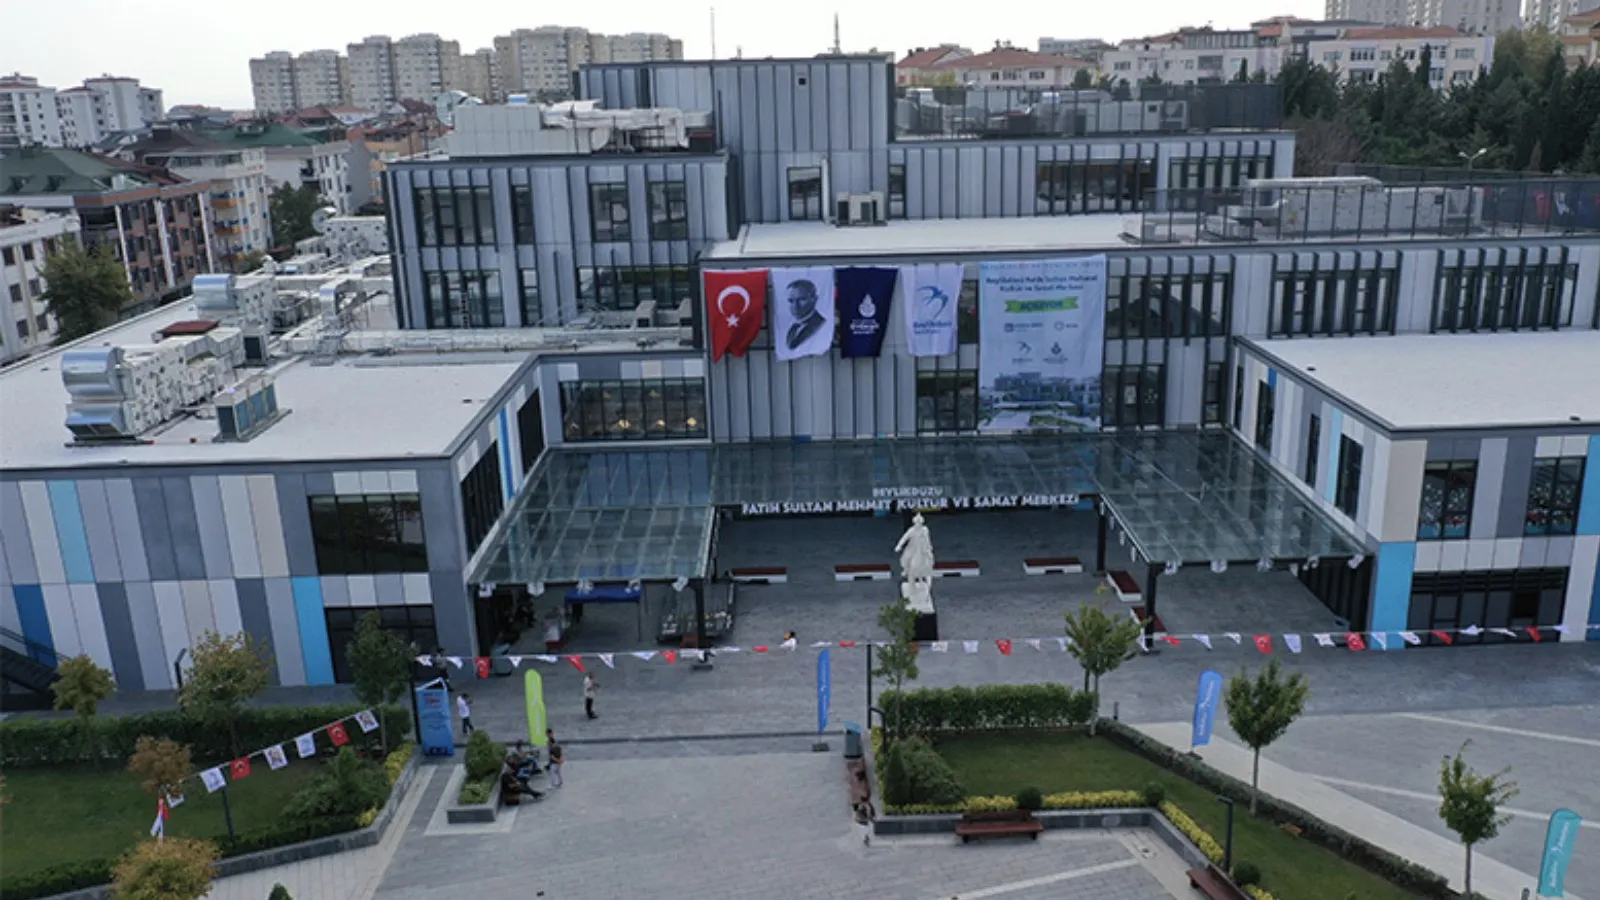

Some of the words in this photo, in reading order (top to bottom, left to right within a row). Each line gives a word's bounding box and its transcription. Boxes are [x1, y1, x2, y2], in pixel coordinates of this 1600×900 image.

[783, 500, 832, 513] SULTAN
[836, 499, 890, 512] MEHMET
[952, 495, 969, 507] VE
